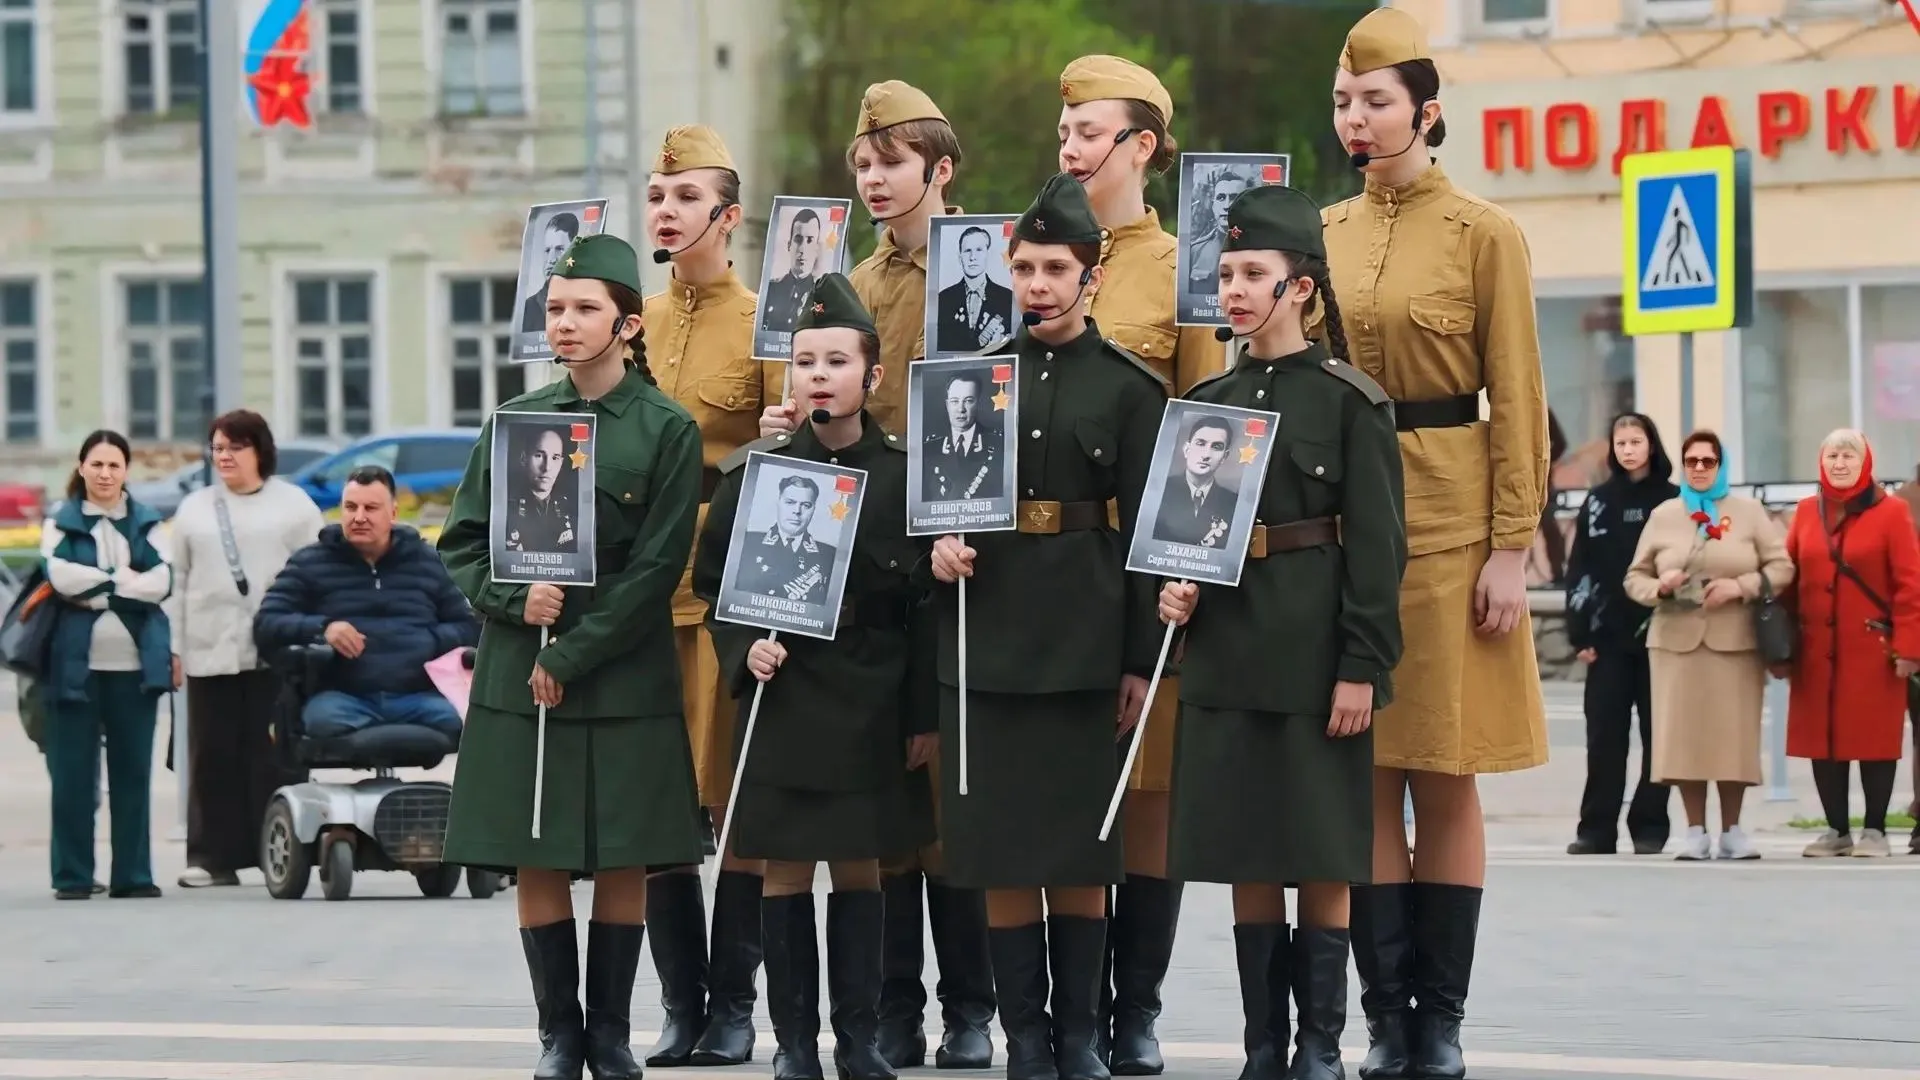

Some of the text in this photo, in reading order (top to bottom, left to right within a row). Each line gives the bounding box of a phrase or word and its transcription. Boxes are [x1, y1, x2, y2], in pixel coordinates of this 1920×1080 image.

[930, 501, 992, 515] ВИНОГРАДОВ
[912, 516, 957, 527] Александр
[522, 553, 563, 565] ГЛАЗКОВ
[1164, 544, 1209, 560] ЗАХАРОВ
[510, 564, 576, 577] Павел Петрович
[1147, 554, 1222, 574] Сергей Иванович
[750, 595, 807, 614] НИКОЛАЕВ
[727, 603, 825, 629] Алексей Михайлович
